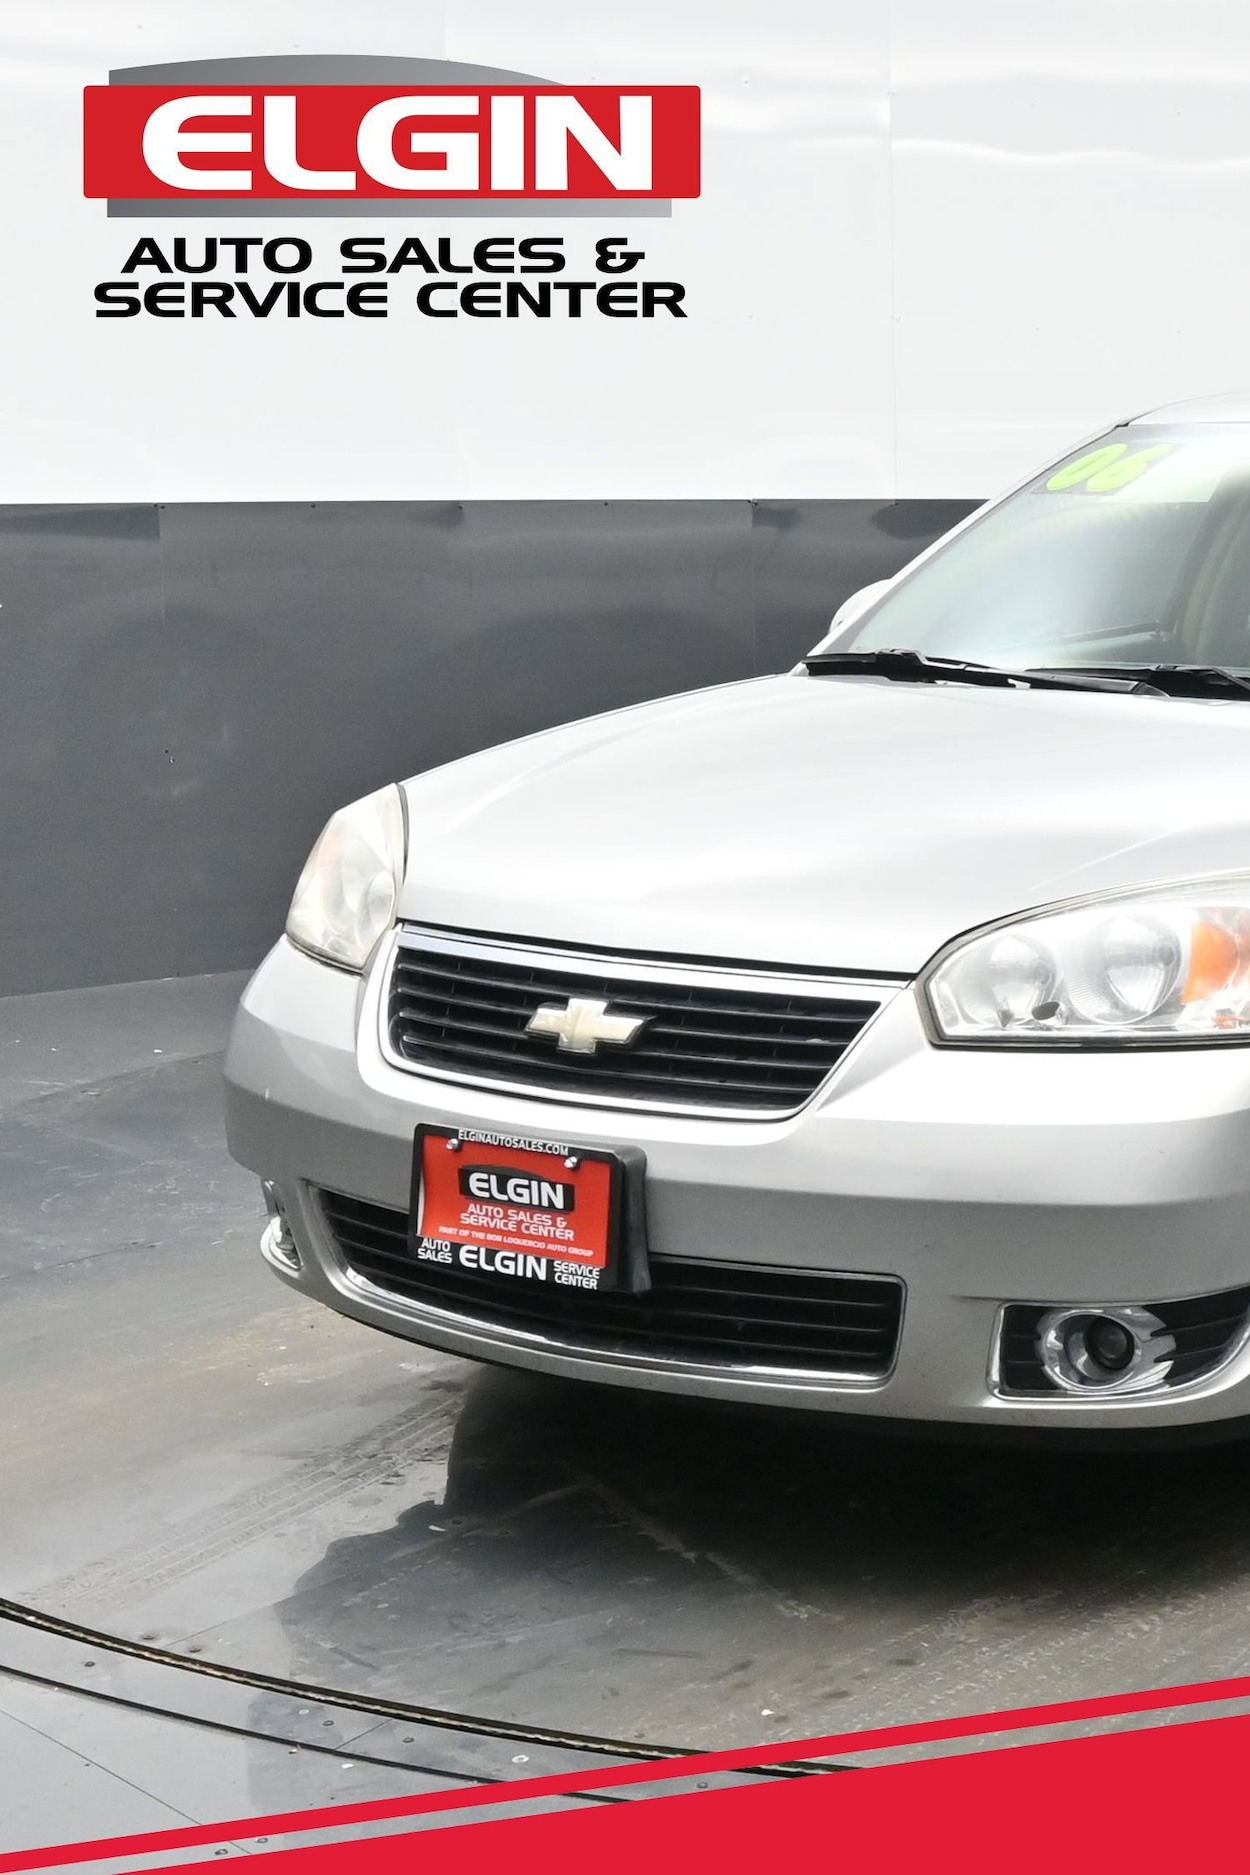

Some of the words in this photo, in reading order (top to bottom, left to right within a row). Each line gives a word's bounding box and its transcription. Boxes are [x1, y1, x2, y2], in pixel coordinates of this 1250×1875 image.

[1046, 443, 1173, 492] 06
[458, 1129, 569, 1156] ELGINAUTOSALES.COM
[469, 1172, 564, 1209] ELGIN
[460, 1213, 517, 1232] SERVICE
[521, 1223, 574, 1241] CENTER
[467, 1203, 503, 1218] AUTO
[508, 1209, 552, 1226] SALES
[556, 1216, 567, 1228] &
[421, 1237, 450, 1252] AUTO
[439, 1226, 458, 1234] PART
[459, 1229, 469, 1237] OF
[471, 1231, 486, 1240] THE
[547, 1243, 567, 1253] AUTO
[568, 1246, 594, 1257] GROUP
[417, 1248, 452, 1264] SALES
[459, 1244, 547, 1281] ELGIN
[553, 1260, 600, 1279] SERVICE
[554, 1273, 598, 1290] CENTER
